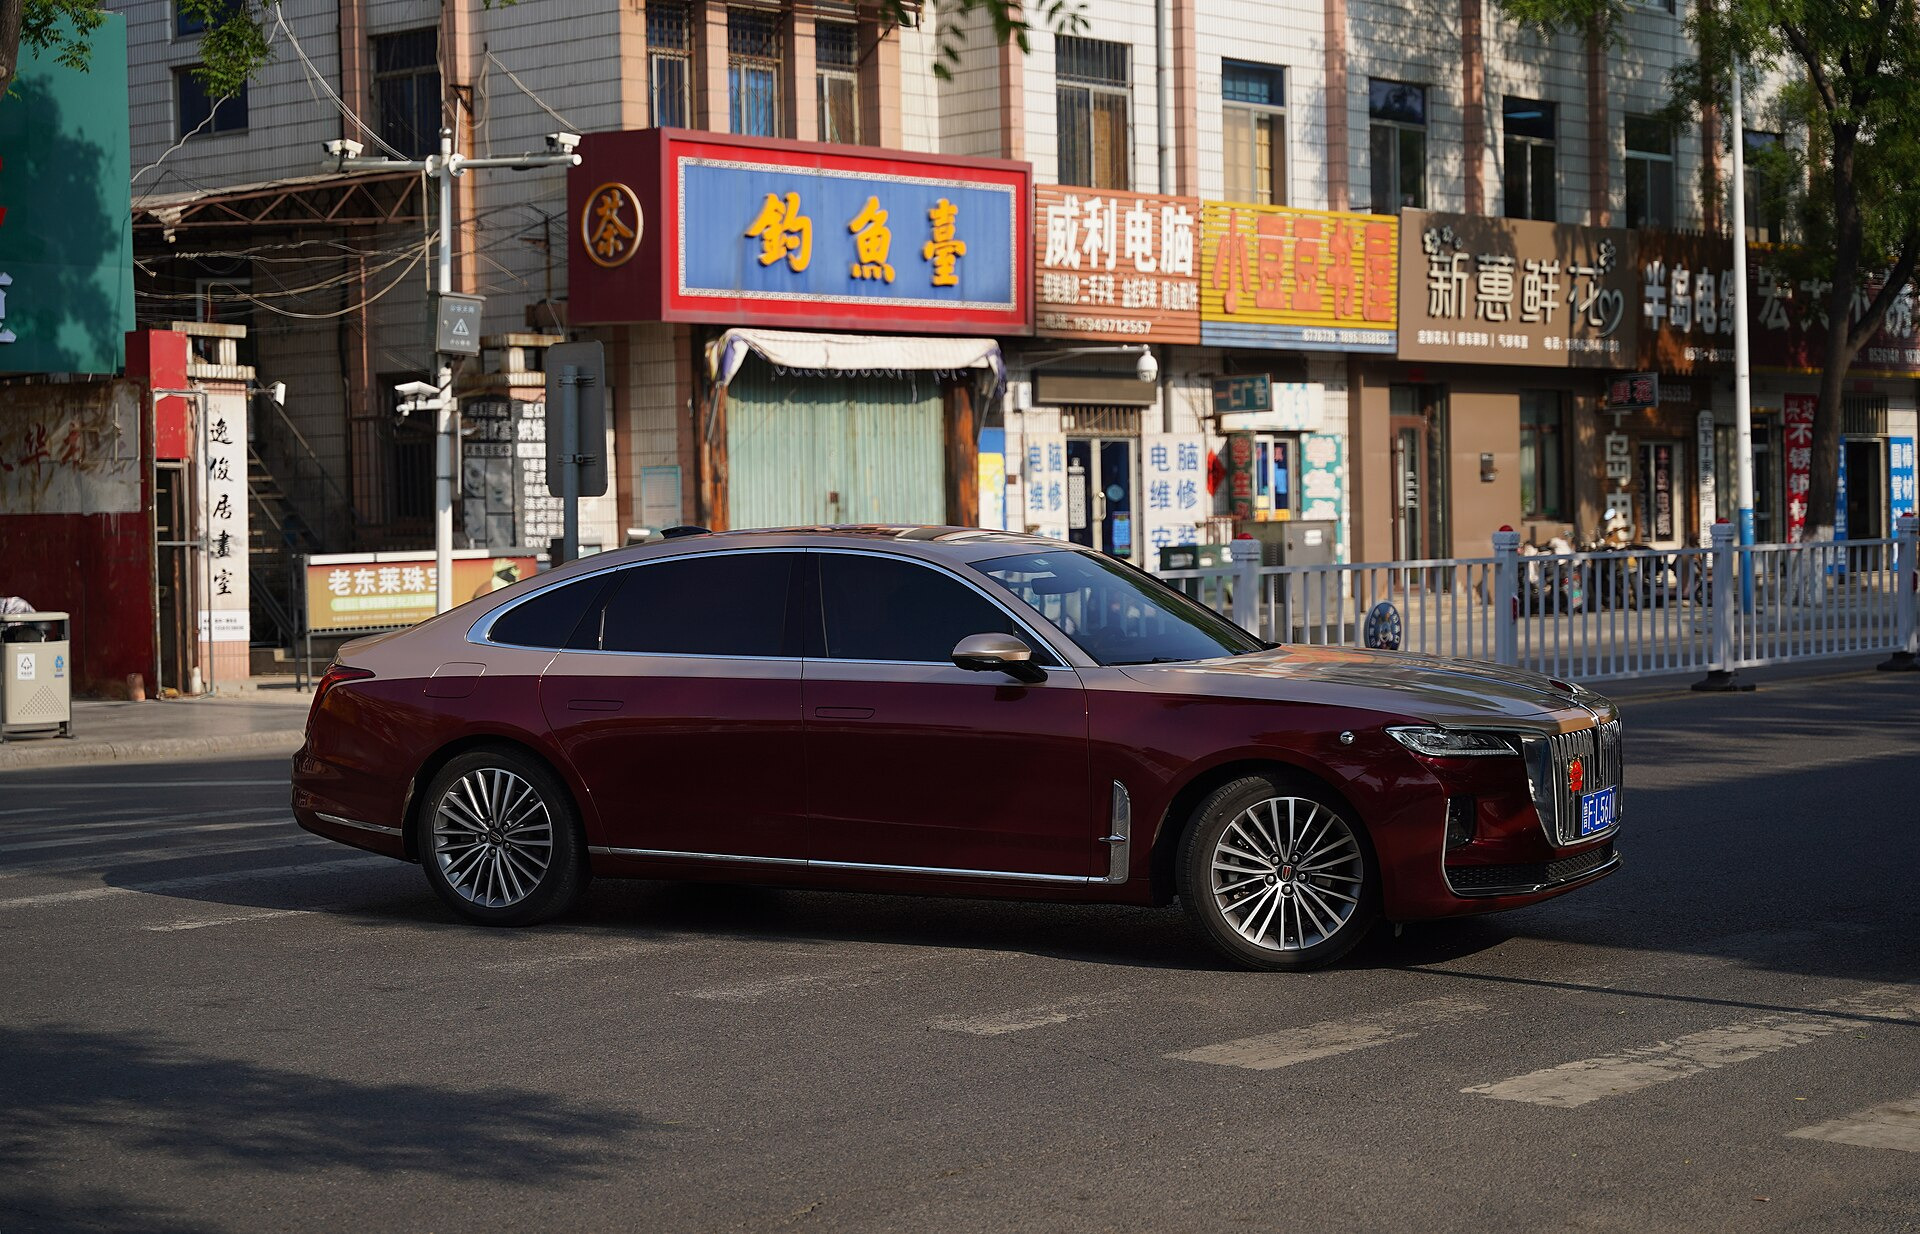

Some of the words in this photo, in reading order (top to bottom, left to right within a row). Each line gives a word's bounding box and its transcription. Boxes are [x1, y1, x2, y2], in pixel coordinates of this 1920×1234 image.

[592, 189, 634, 257] 茶
[1043, 194, 1194, 277] 威利电脑
[1212, 209, 1392, 322] 小豆豆书屋
[1612, 380, 1652, 403] 鲜花
[1150, 442, 1199, 472] 电脑
[1029, 480, 1062, 512] 维修
[1150, 479, 1199, 510] 维修
